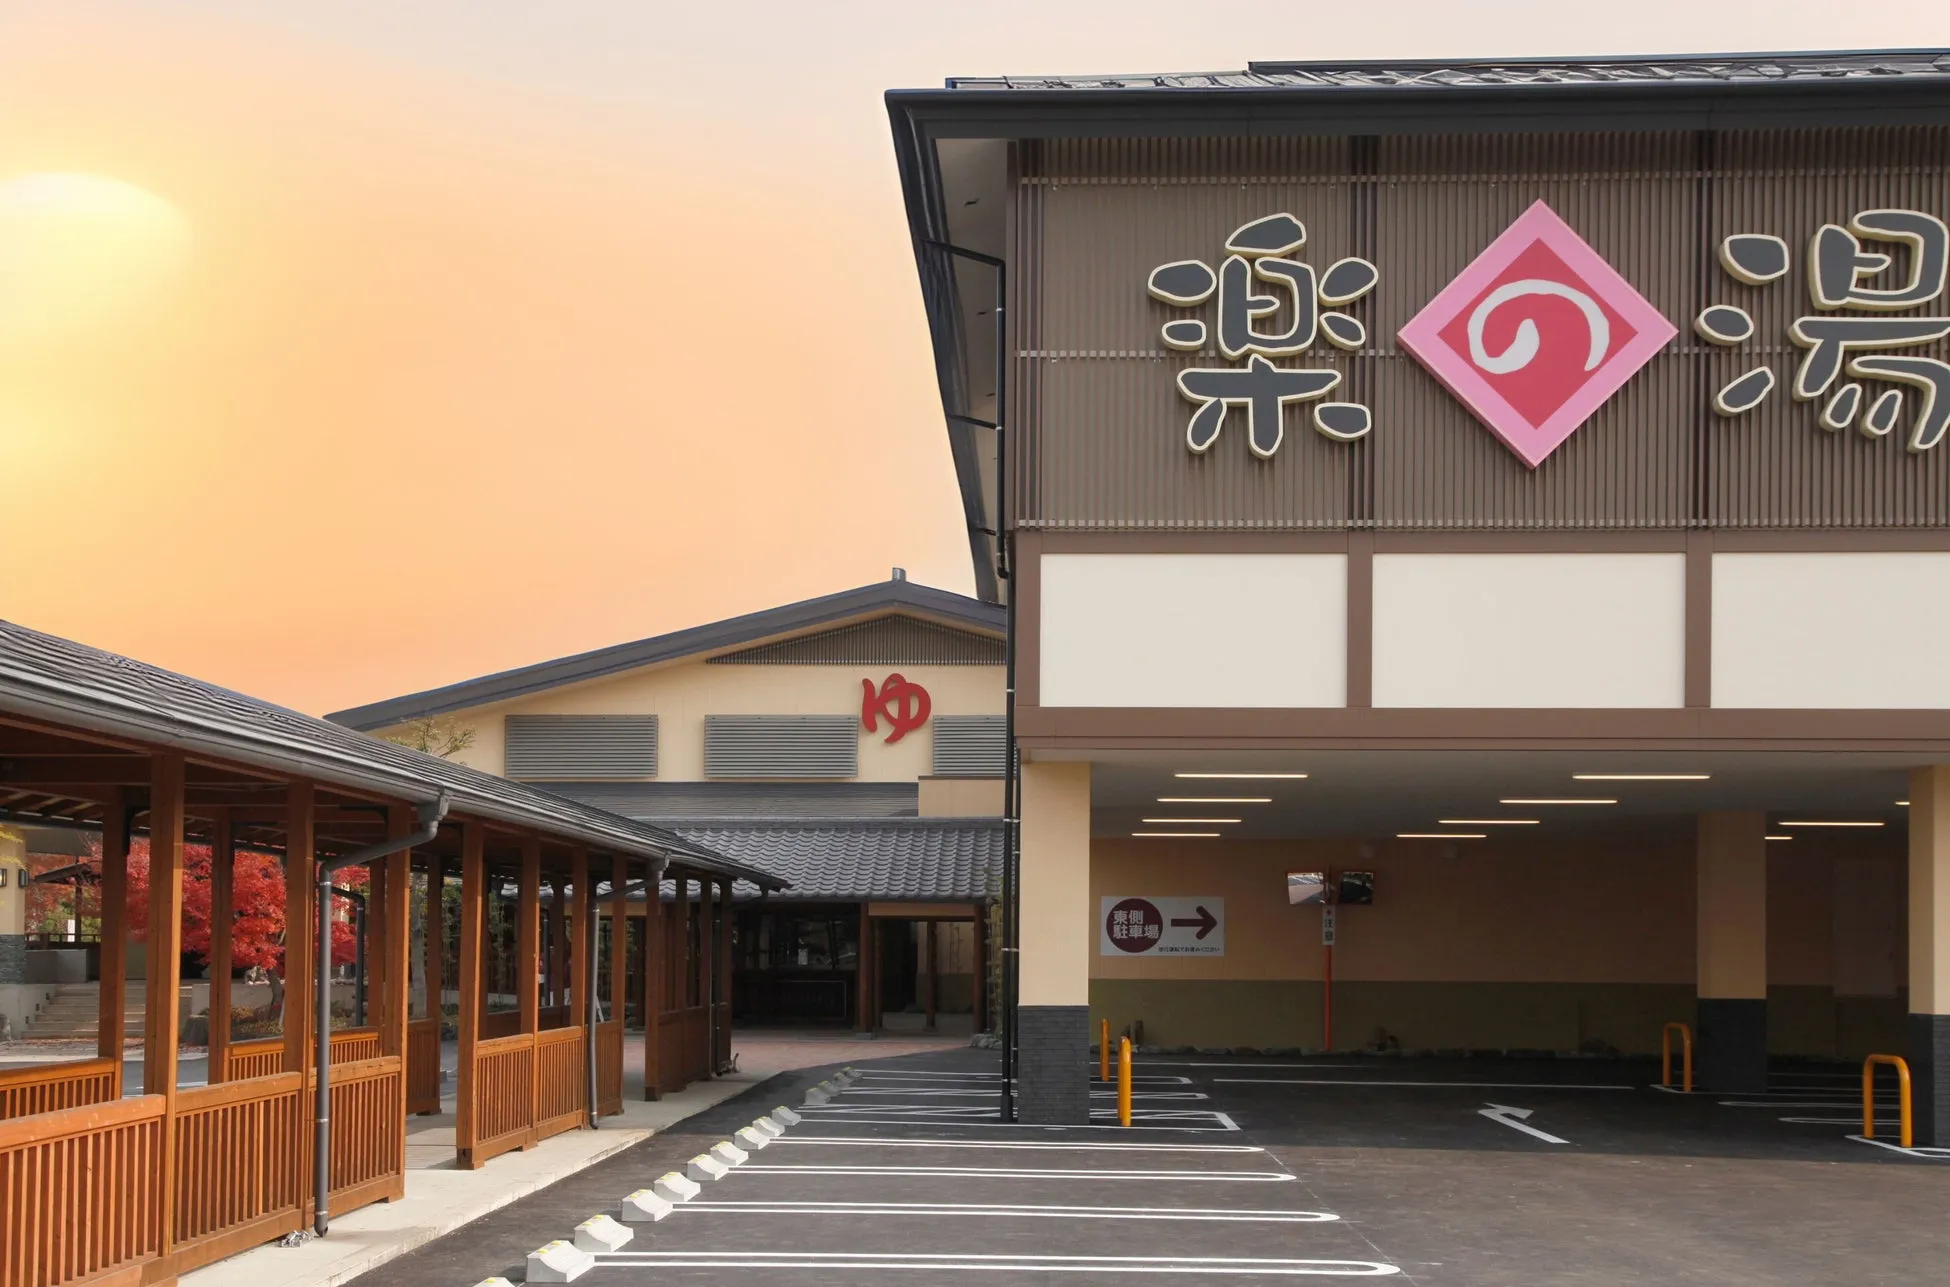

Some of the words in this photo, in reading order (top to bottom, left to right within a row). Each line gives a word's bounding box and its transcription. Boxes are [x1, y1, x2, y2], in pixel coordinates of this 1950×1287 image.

[1147, 208, 1950, 460] 楽の湯
[861, 672, 932, 744] ゆ
[1112, 910, 1144, 924] 東側
[1112, 924, 1160, 939] 駐車場
